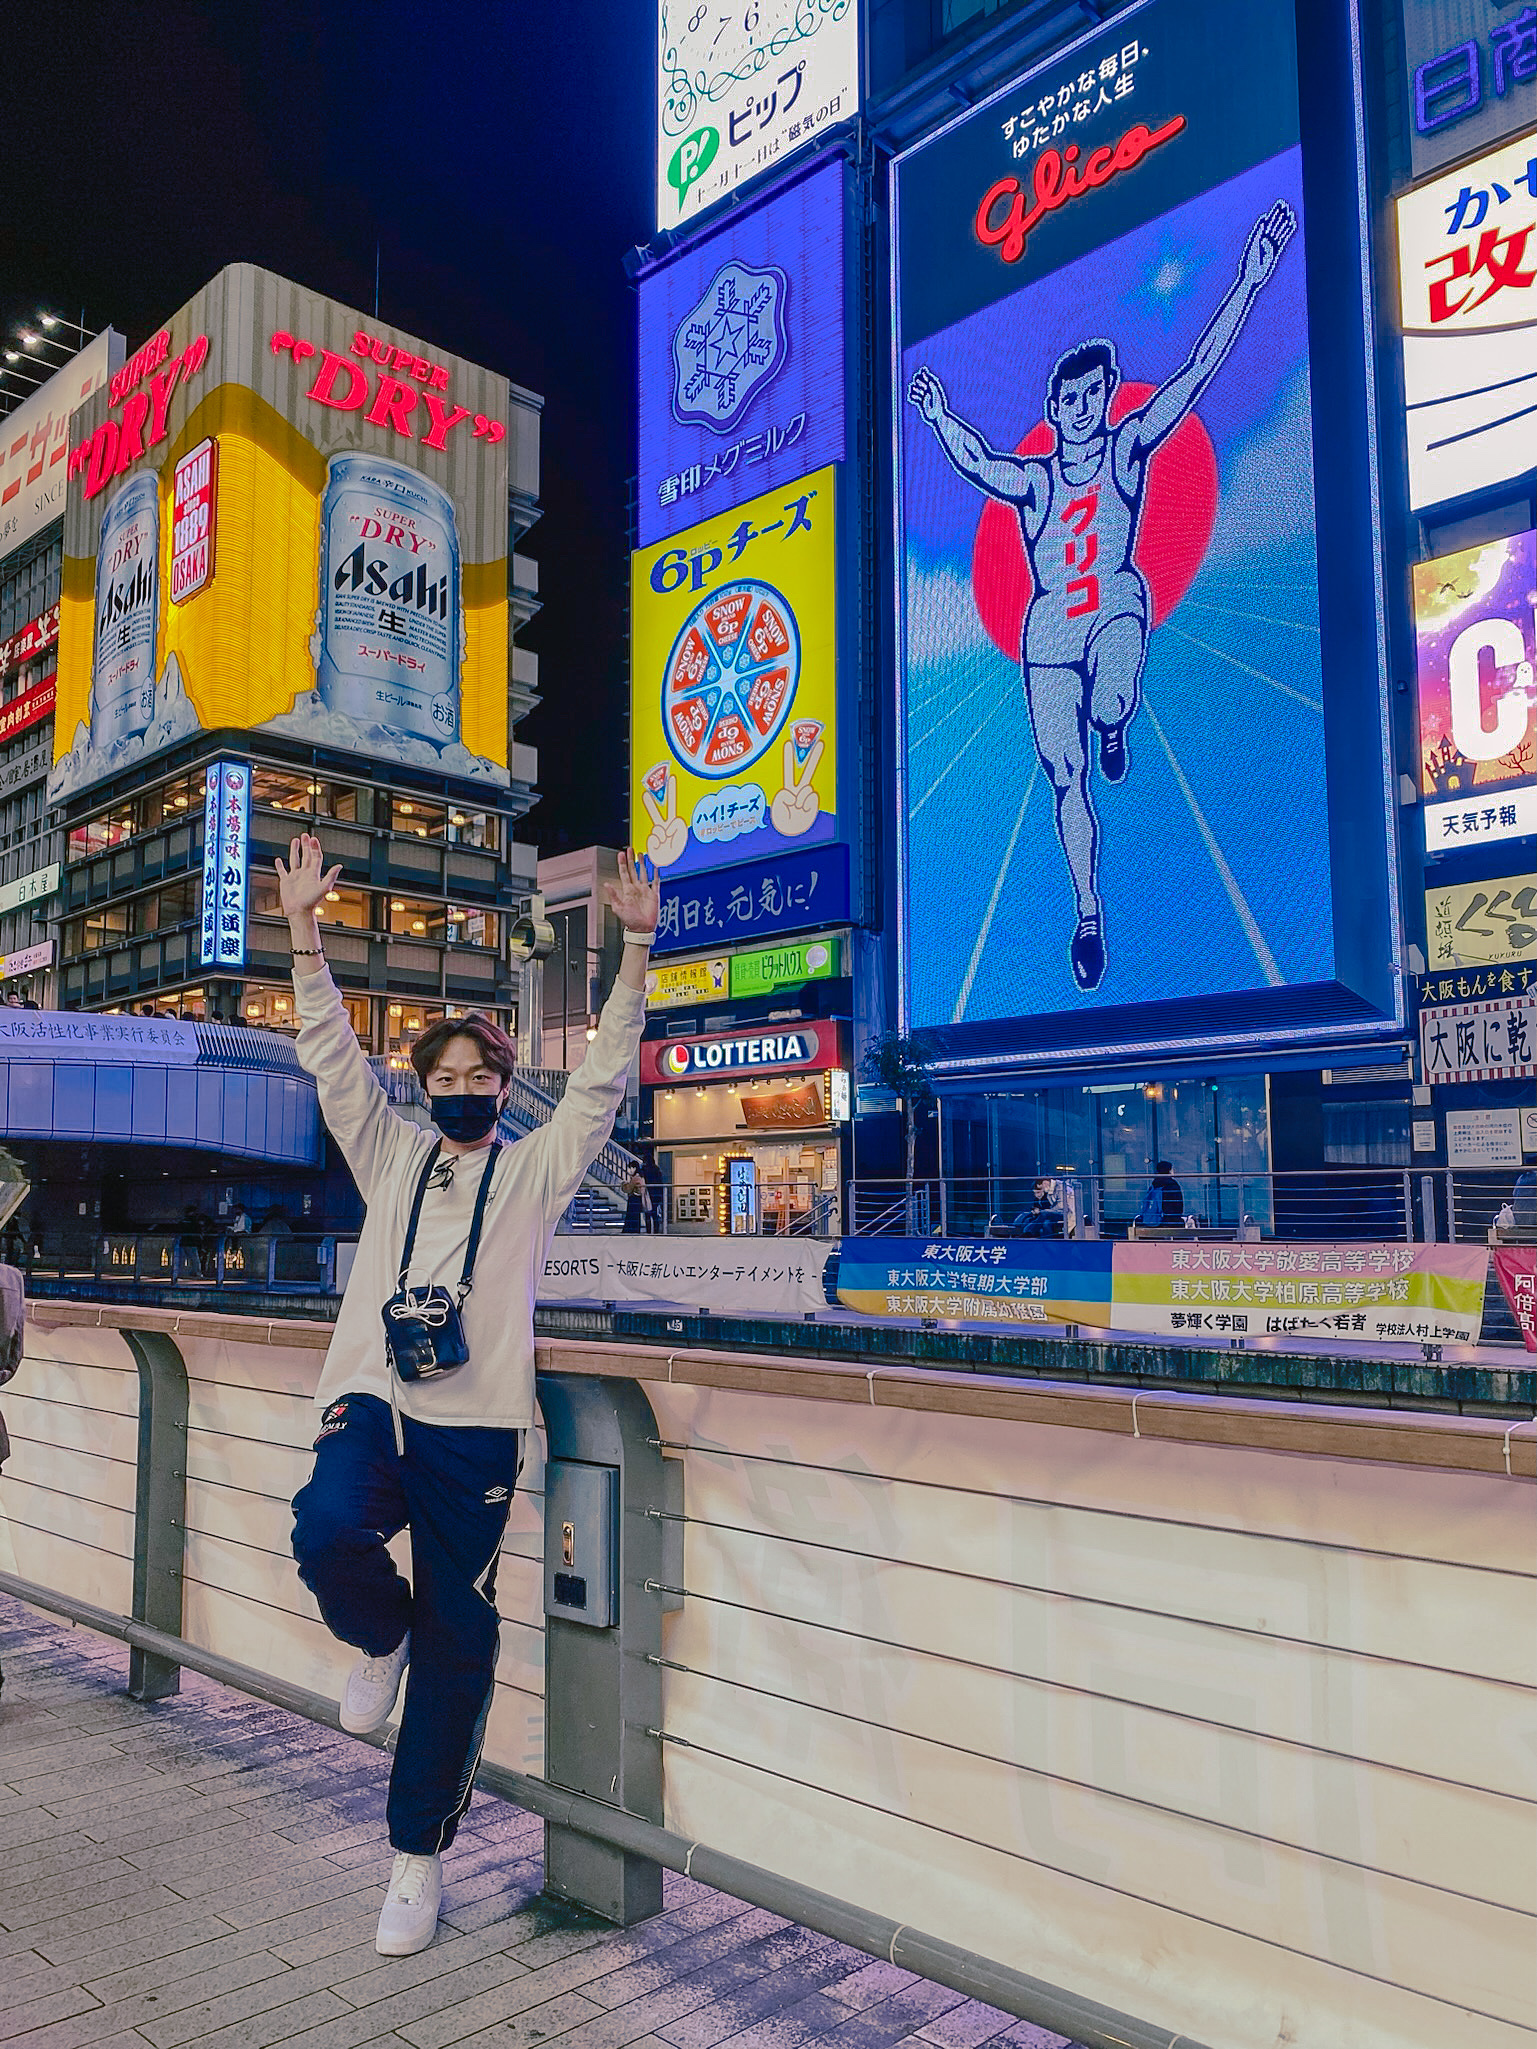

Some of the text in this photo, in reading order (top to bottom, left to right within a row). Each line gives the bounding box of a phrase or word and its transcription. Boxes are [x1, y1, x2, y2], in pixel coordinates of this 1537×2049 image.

[729, 59, 806, 147] ピップ
[1012, 73, 1135, 158] ゆたかな人生
[975, 115, 1186, 263] Glico
[109, 330, 170, 409] SUPER
[350, 330, 451, 391] SUPER
[658, 412, 806, 508] 雪印メグミルク
[175, 449, 210, 509] ASAHI
[174, 501, 209, 556] 1889
[374, 507, 417, 529] SUPER
[1060, 484, 1101, 620] グリコ
[173, 545, 206, 596] OSAKA
[334, 542, 447, 621] Asahi
[100, 556, 153, 638] Asahi
[712, 597, 746, 620] SNOW
[378, 609, 407, 636] 生
[762, 609, 787, 647] SNOW
[358, 645, 426, 673] スーパードライ
[224, 794, 242, 861] 本場の味
[1442, 804, 1517, 837] 天気予報
[761, 951, 803, 980] ピタットハウス
[694, 1035, 802, 1068] LOTTERIA
[544, 1258, 600, 1277] ESORTS
[921, 1244, 1007, 1265] 東大阪大学
[1170, 1247, 1415, 1274] 東大阪大学敬愛高等学校
[887, 1269, 1048, 1297] 東大阪大学短期大学部
[1170, 1278, 1410, 1305] 東大阪大学柏原高等学校
[886, 1294, 1048, 1322] 東大阪大学附属幼稚園
[1170, 1311, 1248, 1333] 夢輝く学園
[1375, 1321, 1470, 1342] 学校法人村上学園
